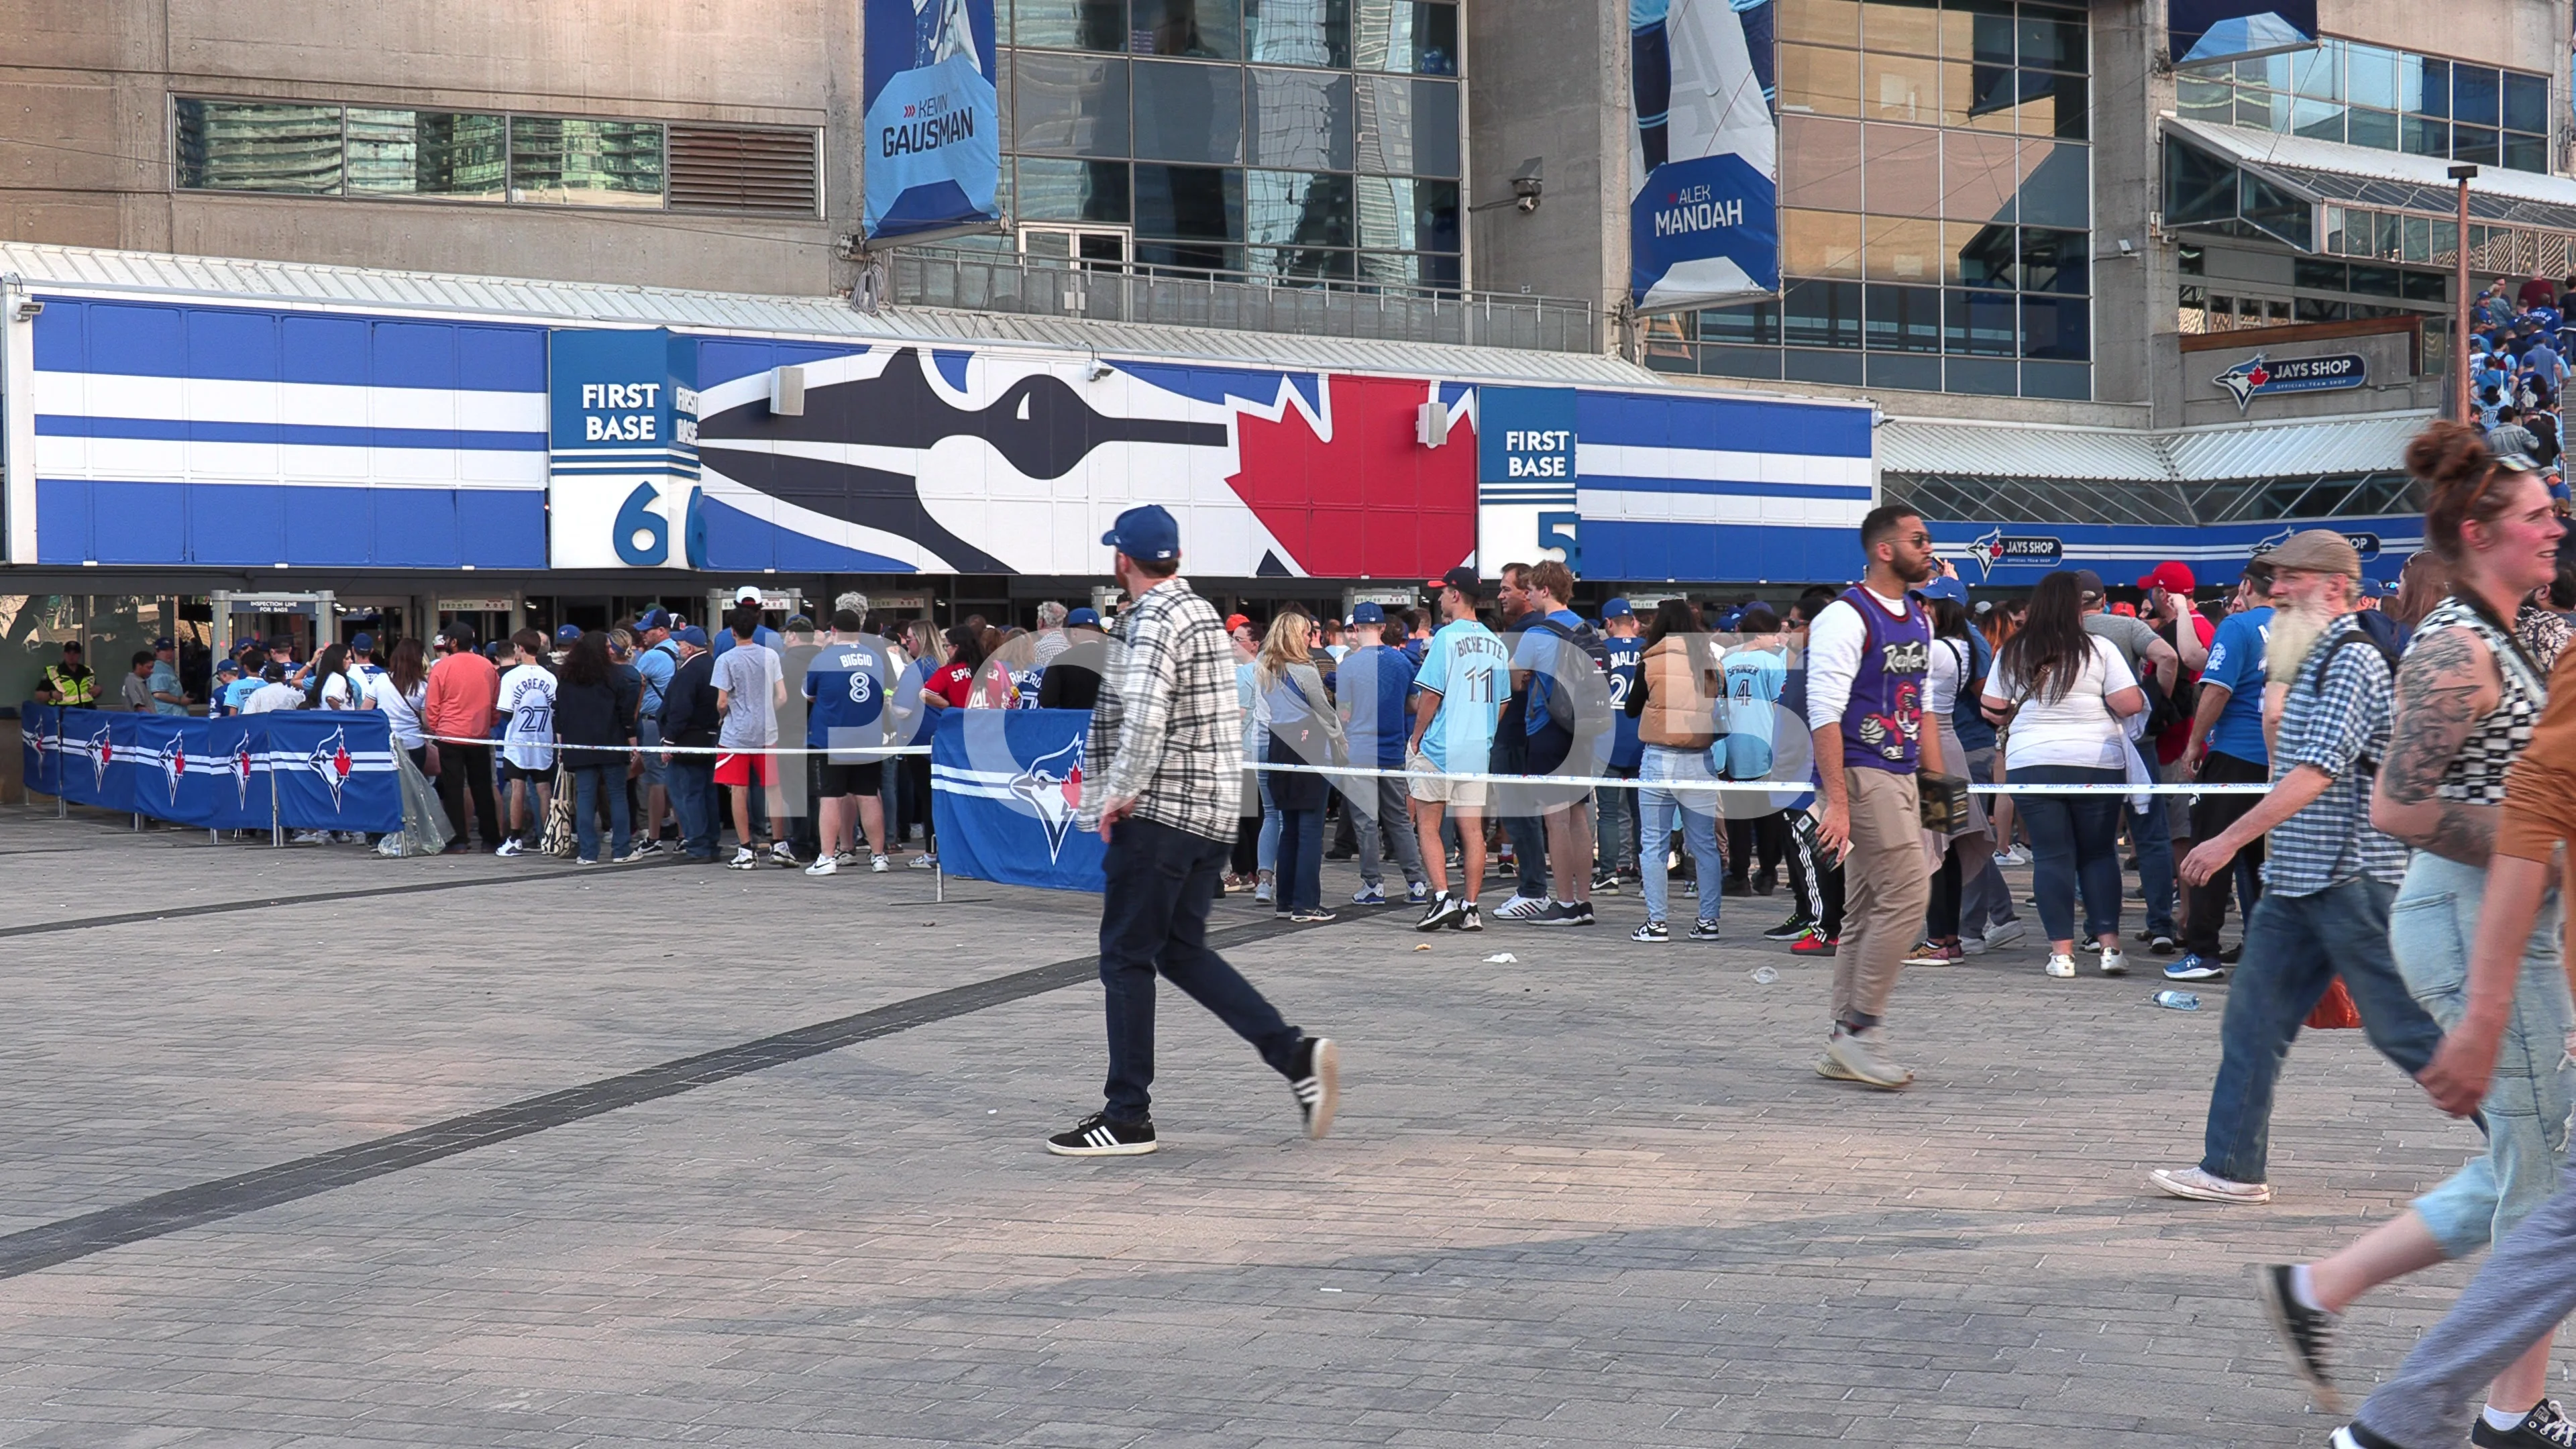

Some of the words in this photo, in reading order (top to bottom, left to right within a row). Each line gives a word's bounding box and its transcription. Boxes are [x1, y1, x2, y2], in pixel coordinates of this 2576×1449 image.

[918, 93, 948, 118] KEVIN
[883, 107, 973, 158] GAUSMAN
[1678, 184, 1711, 205] ALEK
[1655, 199, 1743, 237] MANOAH
[2274, 363, 2309, 378] JAYS
[2312, 360, 2351, 376] SHOP
[582, 383, 660, 410] FIRST
[586, 415, 656, 441] BASE
[1506, 431, 1570, 451] FIRST
[1509, 456, 1566, 477] BASE
[613, 481, 668, 567] 6
[1538, 512, 1581, 574] 5
[2006, 541, 2028, 553] JAYS
[2029, 541, 2054, 553] SHOP
[840, 653, 873, 668] BIGGIO
[1456, 636, 1503, 661] BICHETTE
[1727, 664, 1759, 677] SPRINGER
[849, 672, 870, 703] 8
[1464, 665, 1493, 703] 11
[1733, 679, 1752, 706] 4
[519, 706, 549, 733] 27
